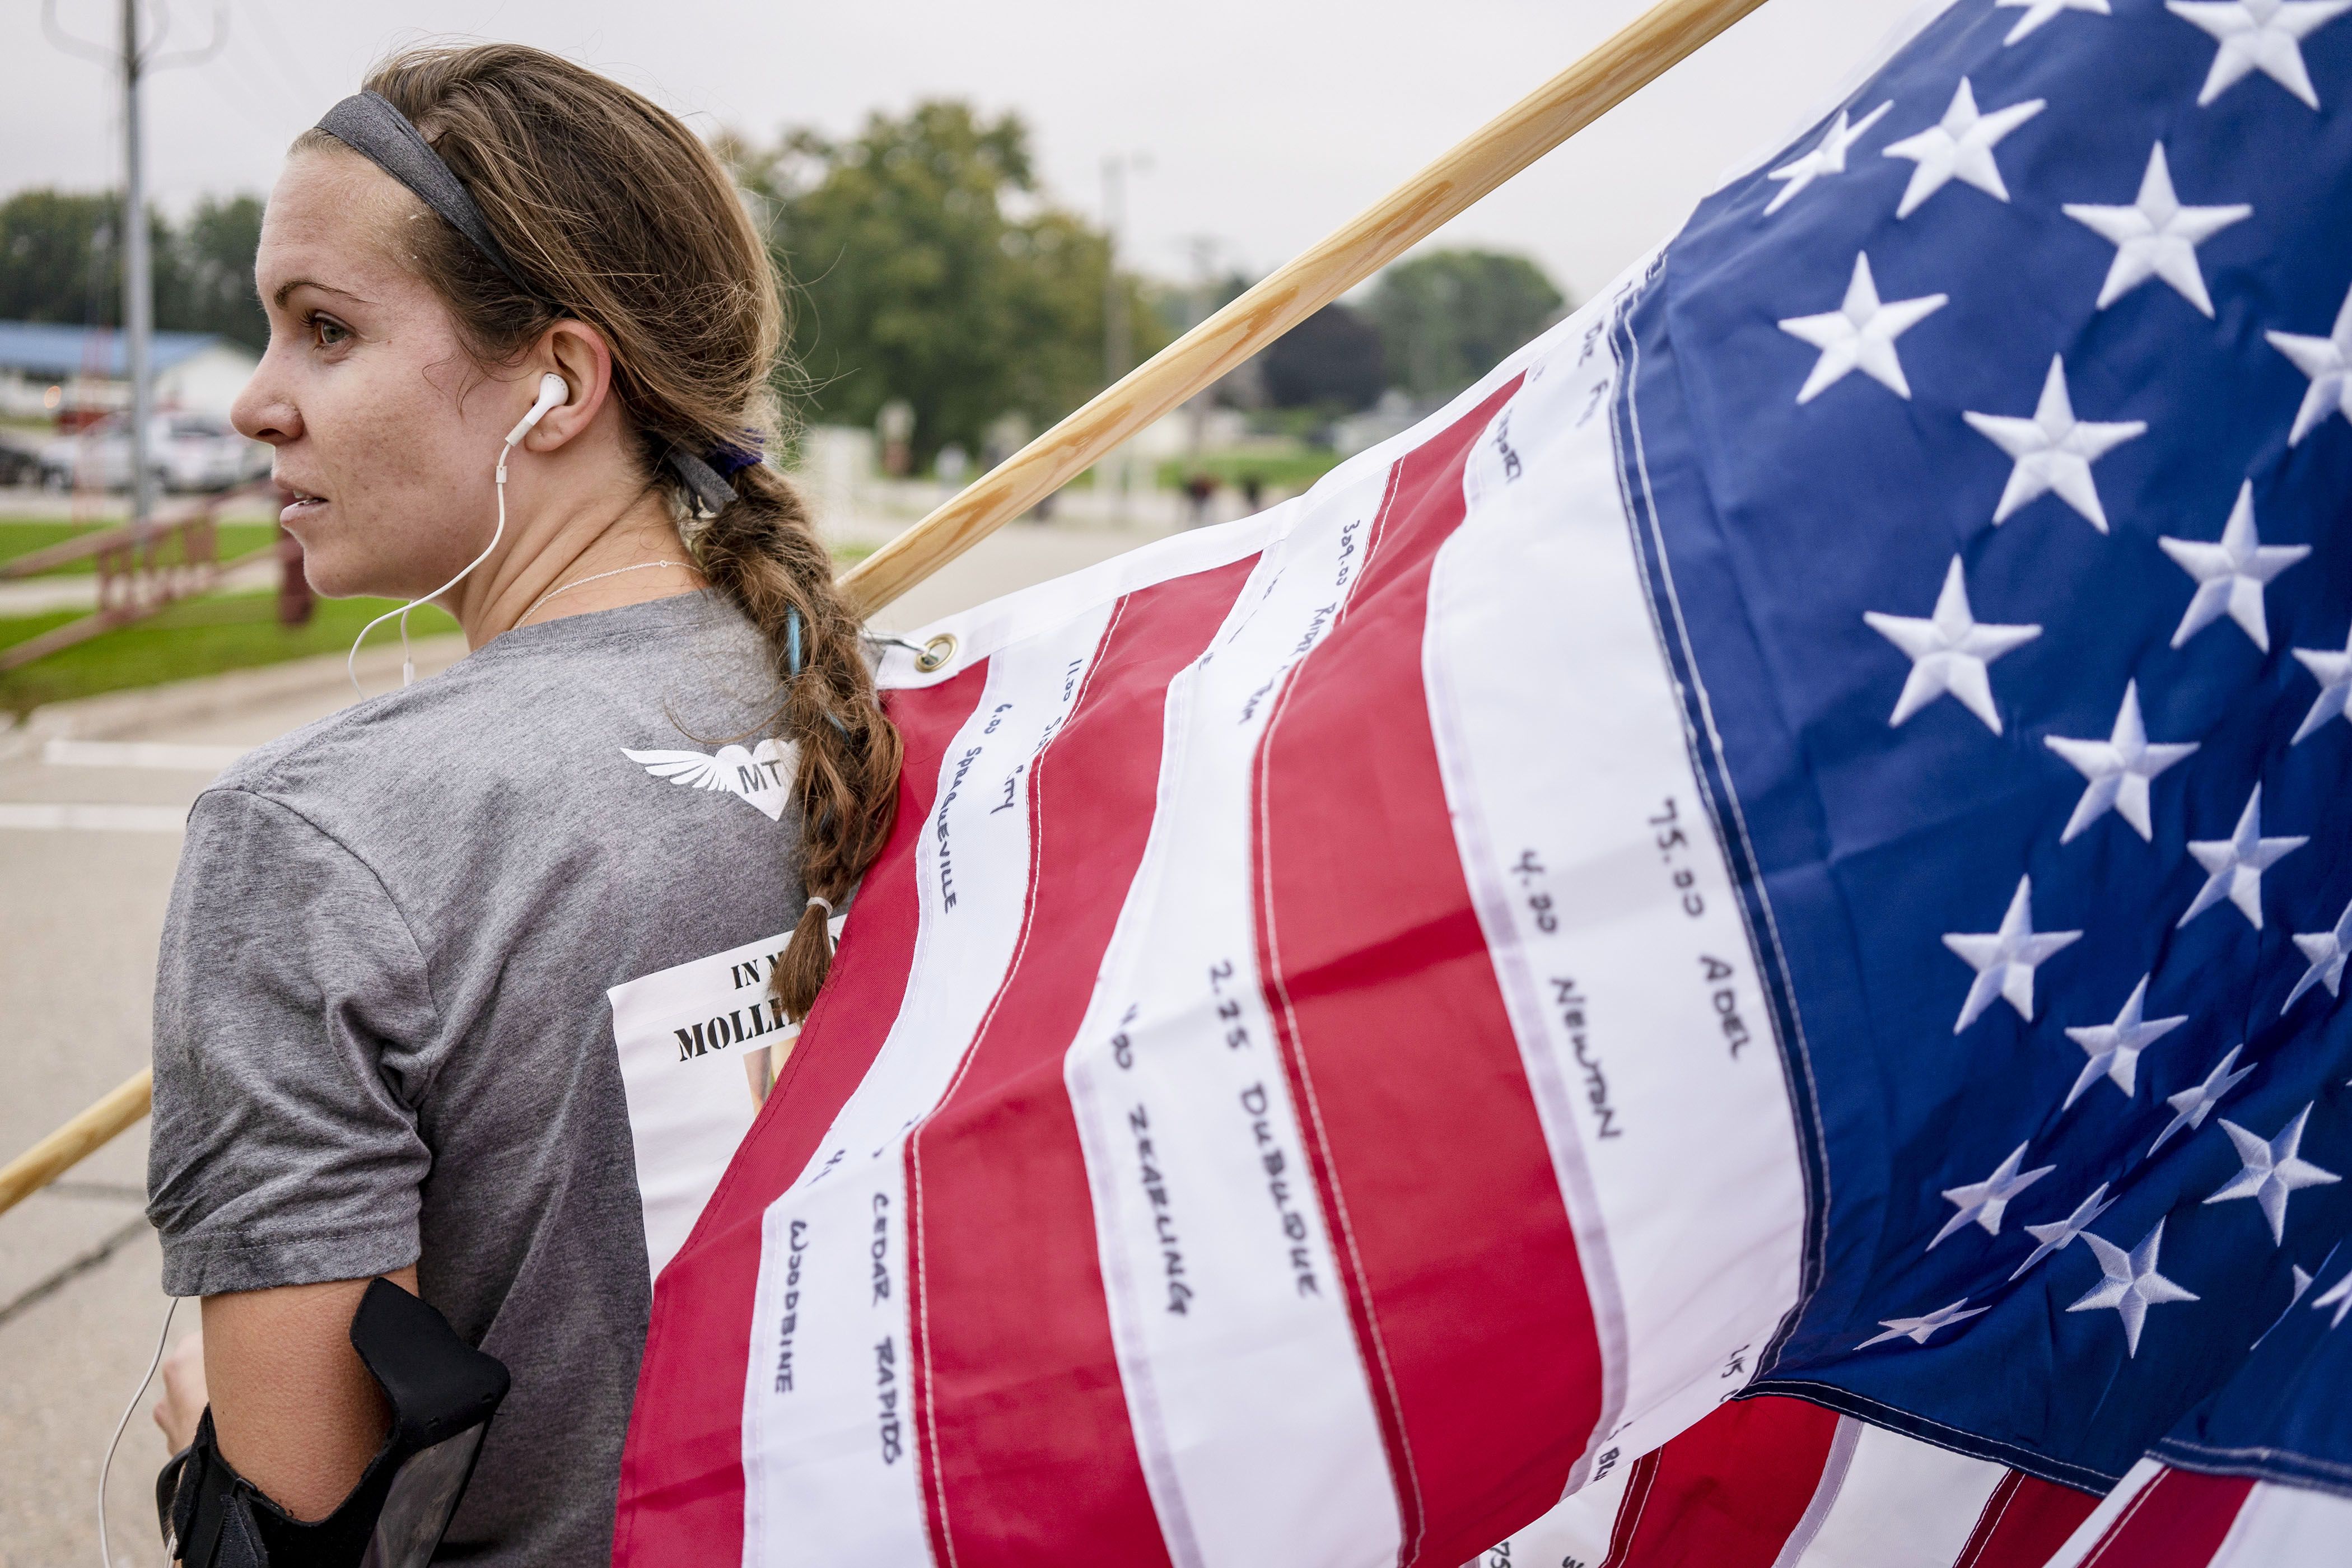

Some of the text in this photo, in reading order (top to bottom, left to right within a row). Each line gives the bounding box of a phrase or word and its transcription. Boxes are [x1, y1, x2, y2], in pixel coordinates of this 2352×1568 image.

[737, 759, 784, 795] MT
[731, 959, 760, 990] IN
[674, 998, 795, 1062] MOLLI
[775, 1220, 809, 1394] WOODBINE
[871, 1192, 902, 1466] CEDAR RAPIDS
